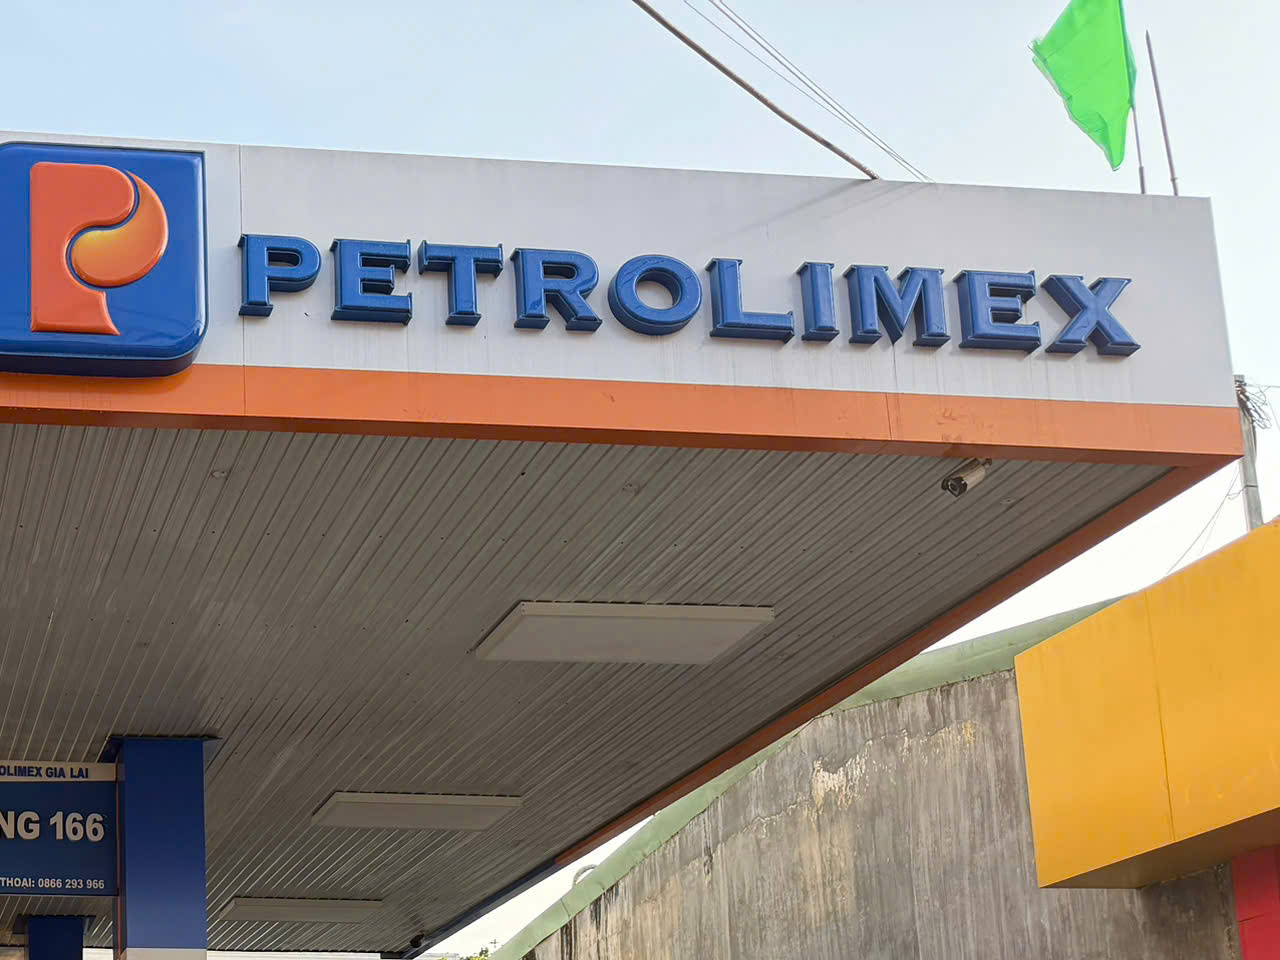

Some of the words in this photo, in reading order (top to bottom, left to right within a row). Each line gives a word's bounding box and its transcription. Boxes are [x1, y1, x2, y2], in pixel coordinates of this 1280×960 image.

[238, 233, 1141, 357] PETROLIMEX
[45, 767, 66, 779] GIA
[70, 767, 89, 779] LAI
[49, 811, 105, 842] 166
[0, 876, 35, 889] THOẠI:
[38, 878, 62, 888] 0866
[65, 878, 83, 889] 293
[86, 879, 105, 889] 966
